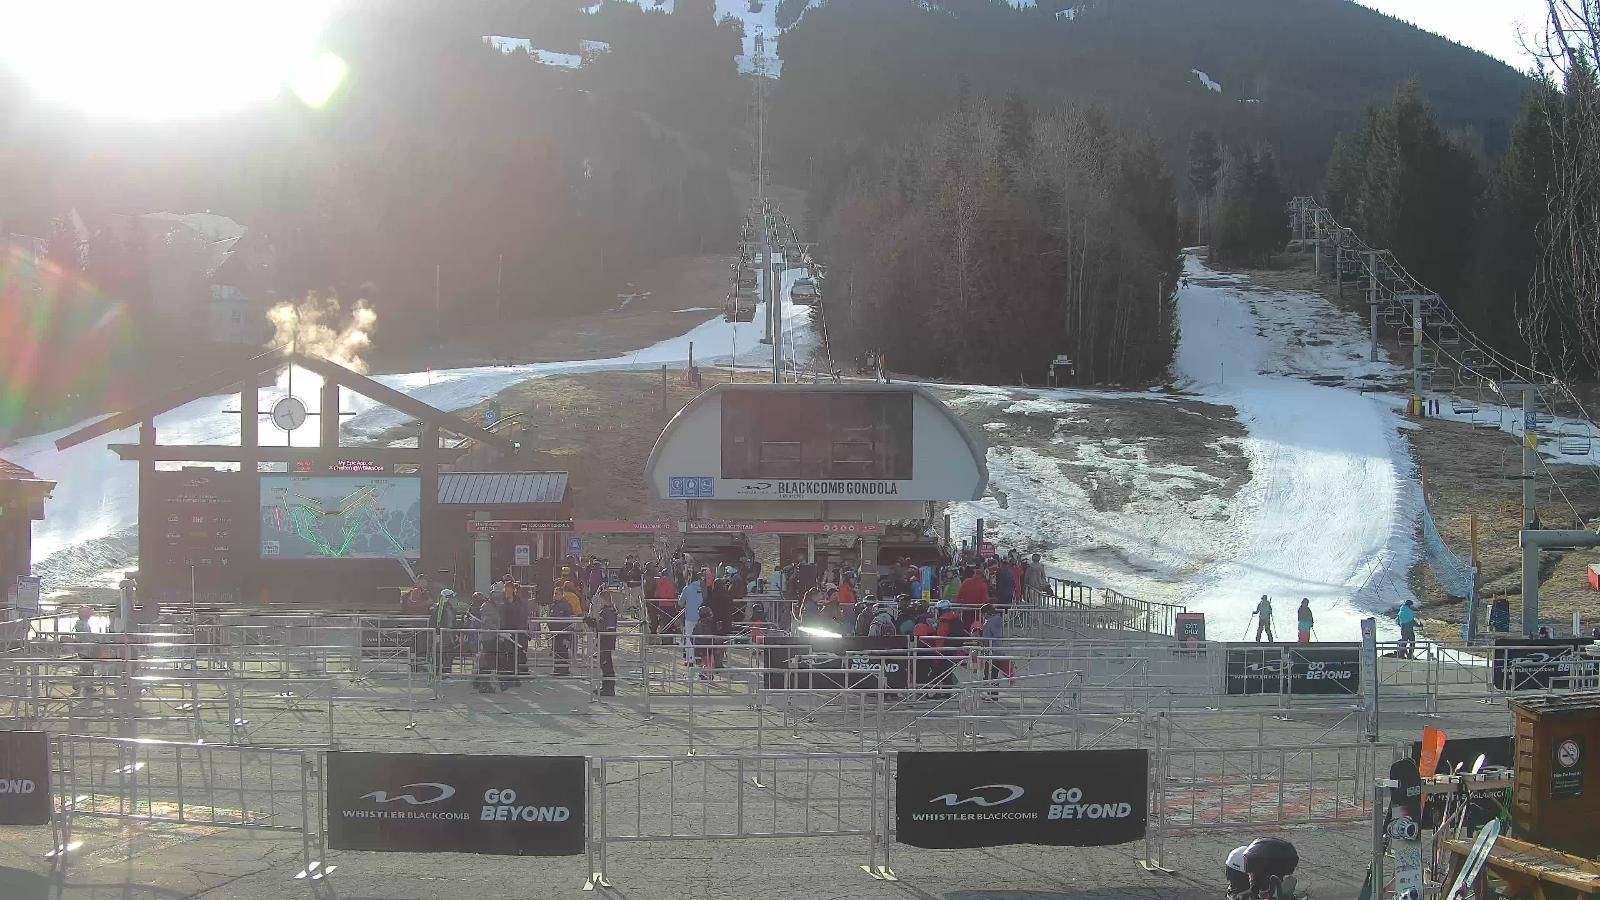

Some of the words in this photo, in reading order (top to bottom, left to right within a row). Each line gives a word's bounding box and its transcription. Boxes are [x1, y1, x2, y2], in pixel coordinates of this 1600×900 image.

[778, 481, 845, 494] BLACKCOMB
[847, 481, 898, 495] GONDOLA
[1308, 661, 1325, 670] GO
[1306, 670, 1351, 680] BEYOND
[484, 788, 517, 803] GO
[1051, 787, 1083, 804] GO
[342, 809, 405, 819] WHISTLER
[406, 811, 470, 821] BLACKCOMB
[480, 805, 570, 822] BEYOND
[912, 812, 976, 821] WHISTLER
[976, 811, 1038, 820] BLACKCOMB
[1047, 802, 1132, 820] BEYOND
